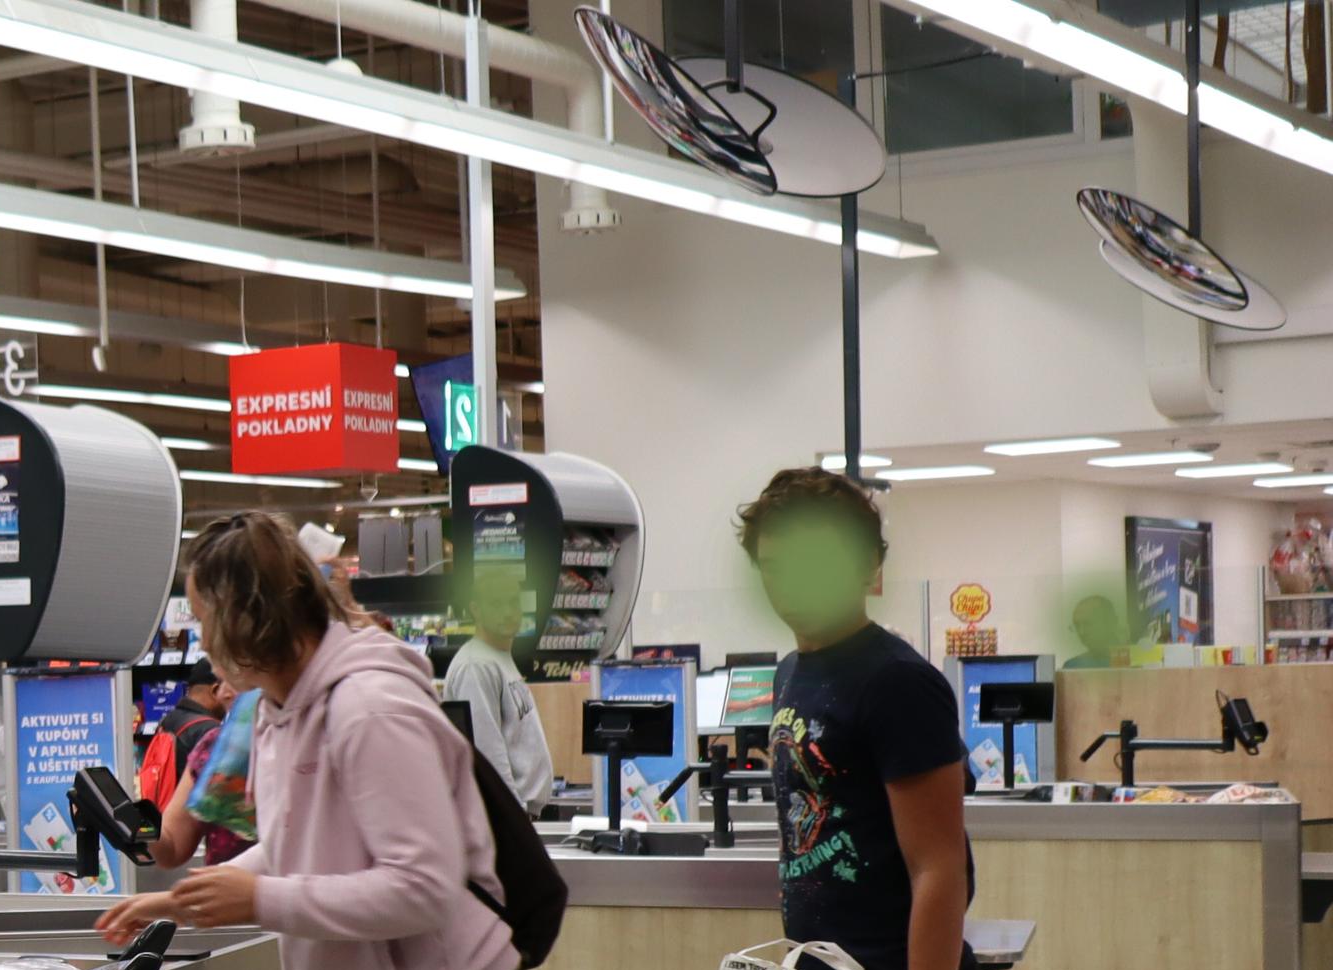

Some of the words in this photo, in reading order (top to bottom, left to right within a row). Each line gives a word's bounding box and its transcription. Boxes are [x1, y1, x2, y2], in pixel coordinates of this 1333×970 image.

[237, 385, 331, 416] EXPRESNÍ
[344, 389, 393, 413] EXPRESNÍ
[237, 414, 333, 438] POKLADNY
[344, 415, 394, 436] POKLADNY
[21, 713, 88, 728] AKTIVUJTE
[92, 712, 103, 724] SI
[36, 727, 89, 743] KUPÓNY
[29, 747, 37, 758] V
[40, 744, 98, 757] APLIKACI
[27, 762, 36, 772] A
[33, 775, 77, 785] KAUFLAN
